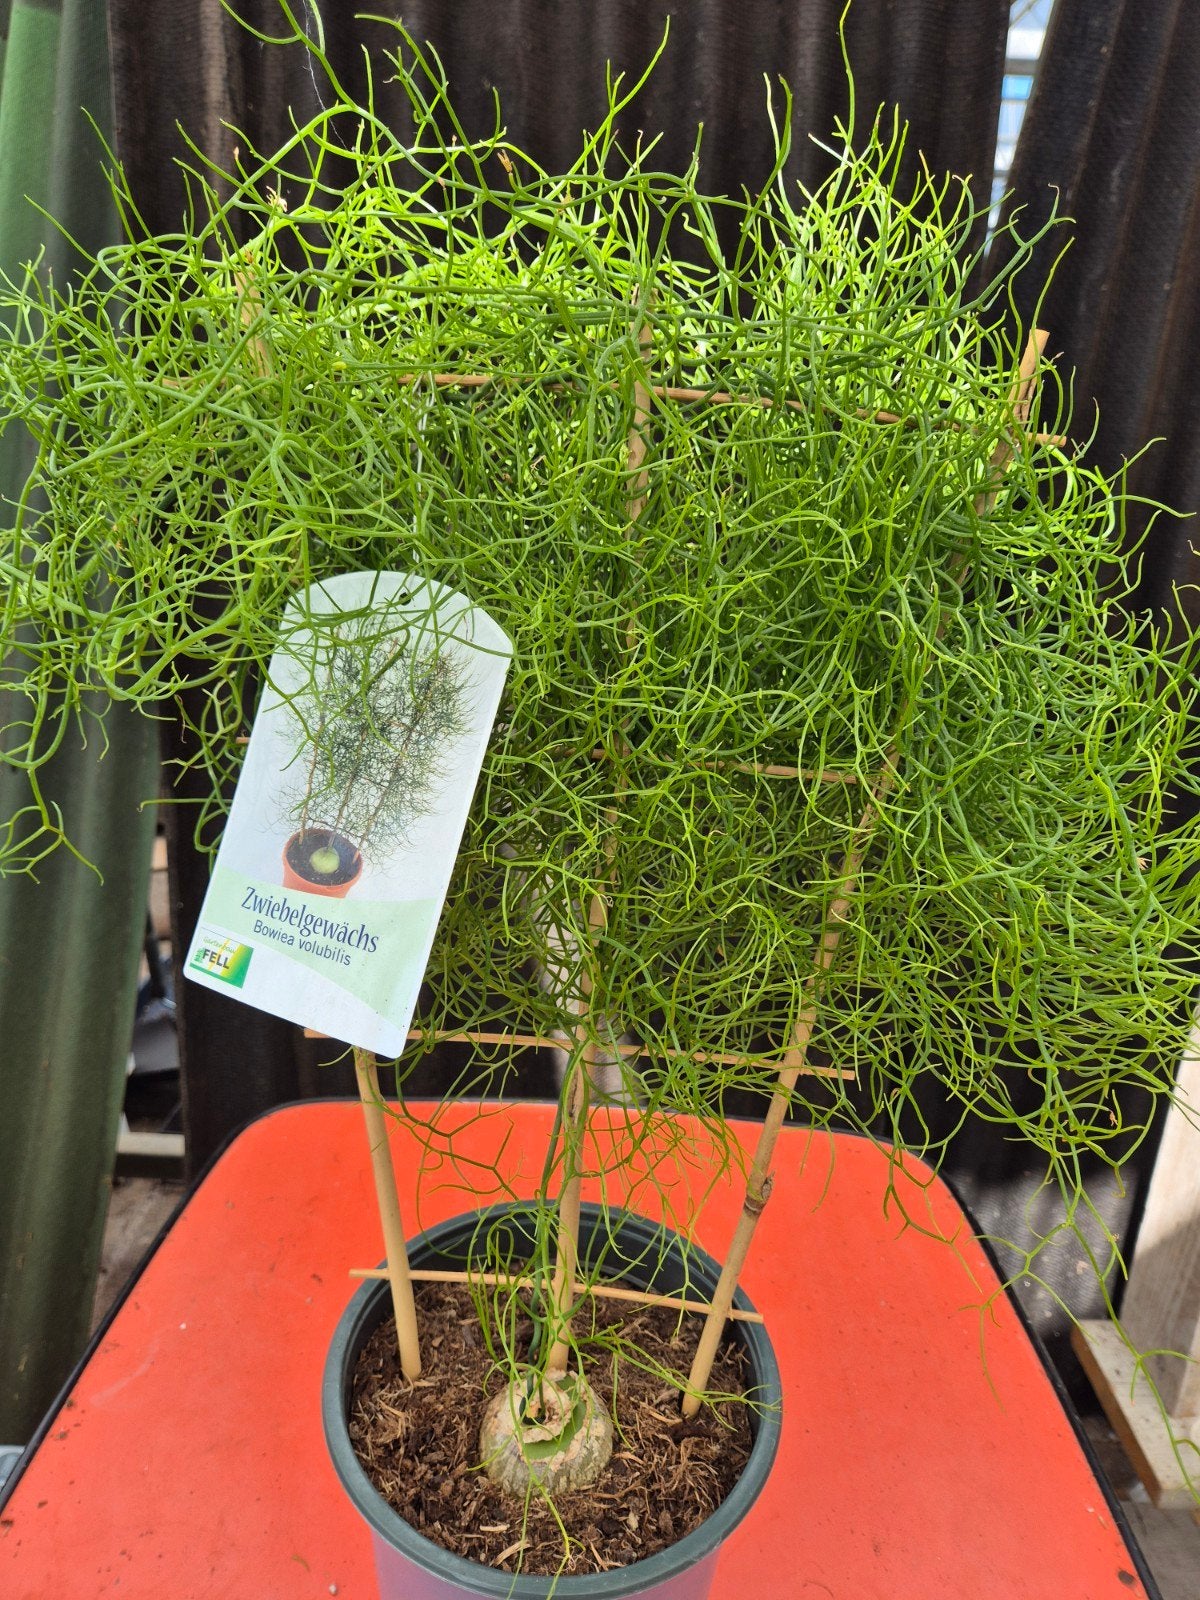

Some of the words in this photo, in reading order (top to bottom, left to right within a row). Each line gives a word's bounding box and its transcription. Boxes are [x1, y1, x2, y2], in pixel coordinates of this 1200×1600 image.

[241, 886, 380, 953] Zwiebelgewächs
[253, 919, 295, 946] Bowiea
[299, 938, 351, 966] volubilis
[202, 948, 230, 970] FELL
